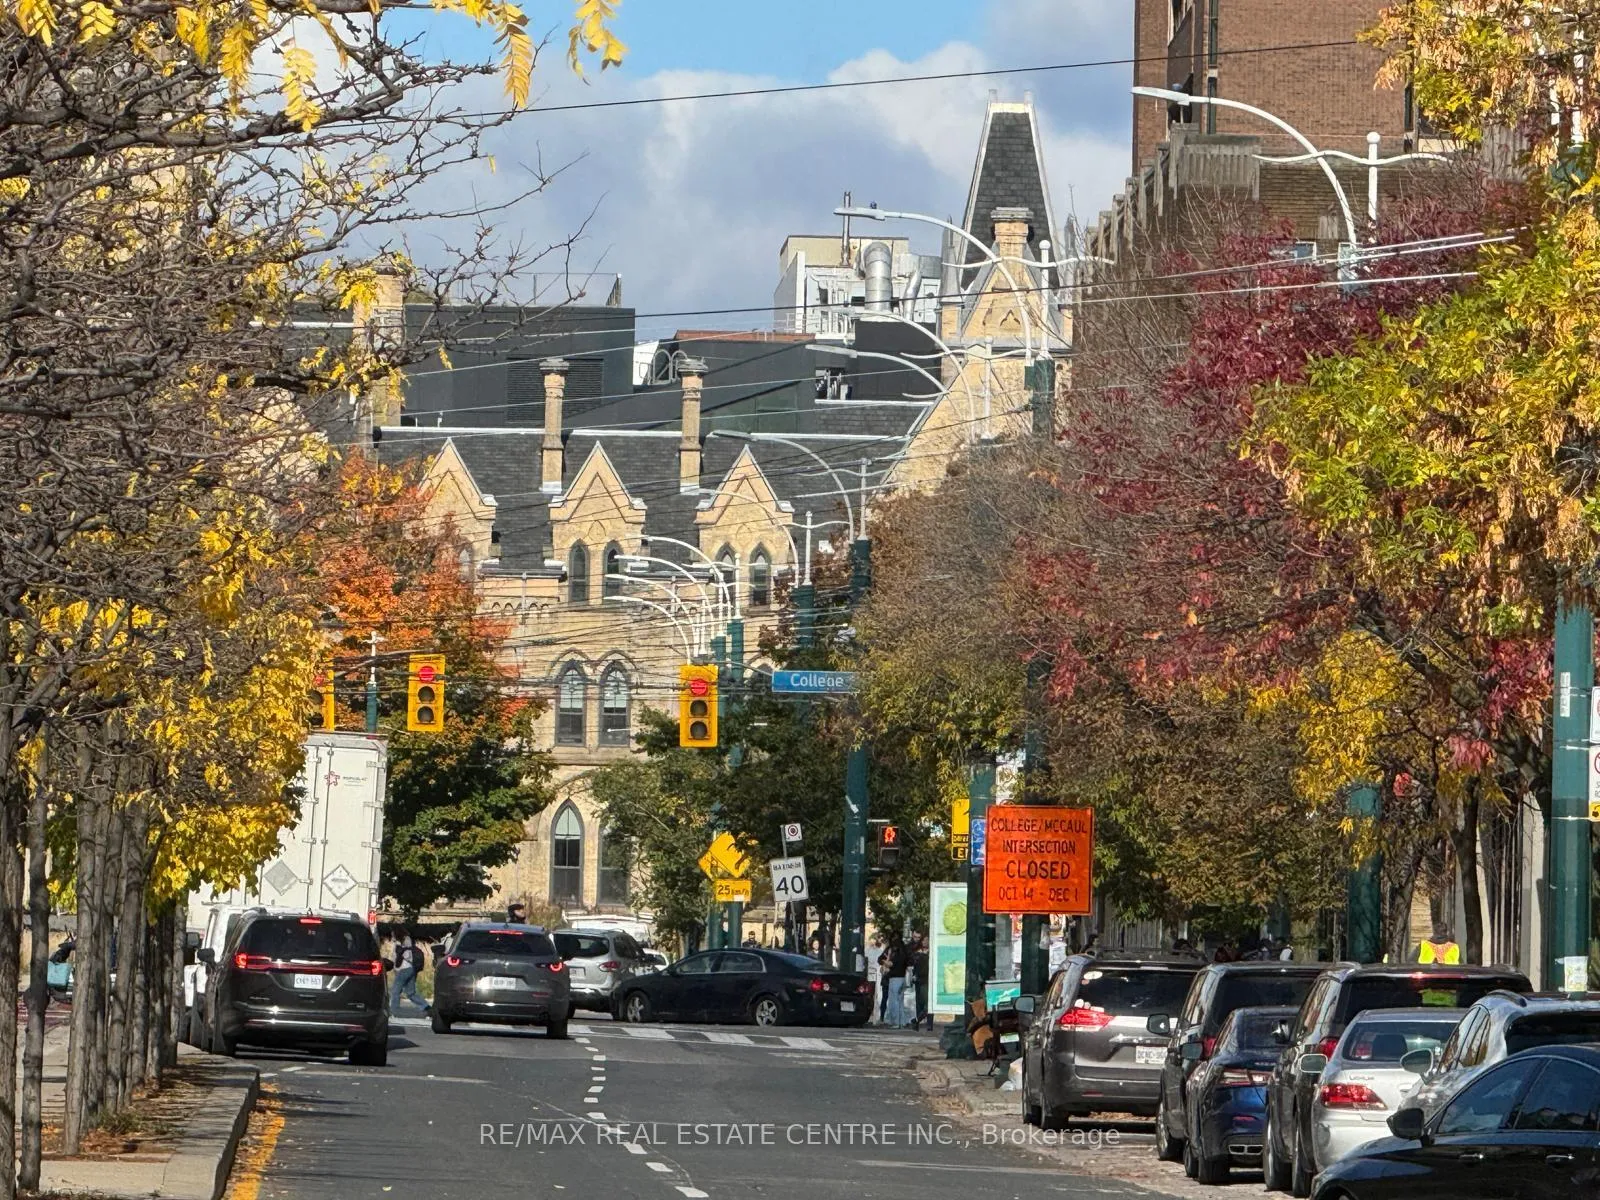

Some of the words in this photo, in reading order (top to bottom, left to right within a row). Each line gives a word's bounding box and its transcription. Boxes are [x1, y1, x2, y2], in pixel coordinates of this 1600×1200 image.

[790, 673, 844, 691] College
[1003, 840, 1076, 855] INTERSECTION
[1006, 860, 1070, 879] CLOSED
[718, 884, 731, 895] 25
[776, 875, 804, 894] 40
[1023, 887, 1034, 901] 14
[1048, 887, 1070, 902] DEC
